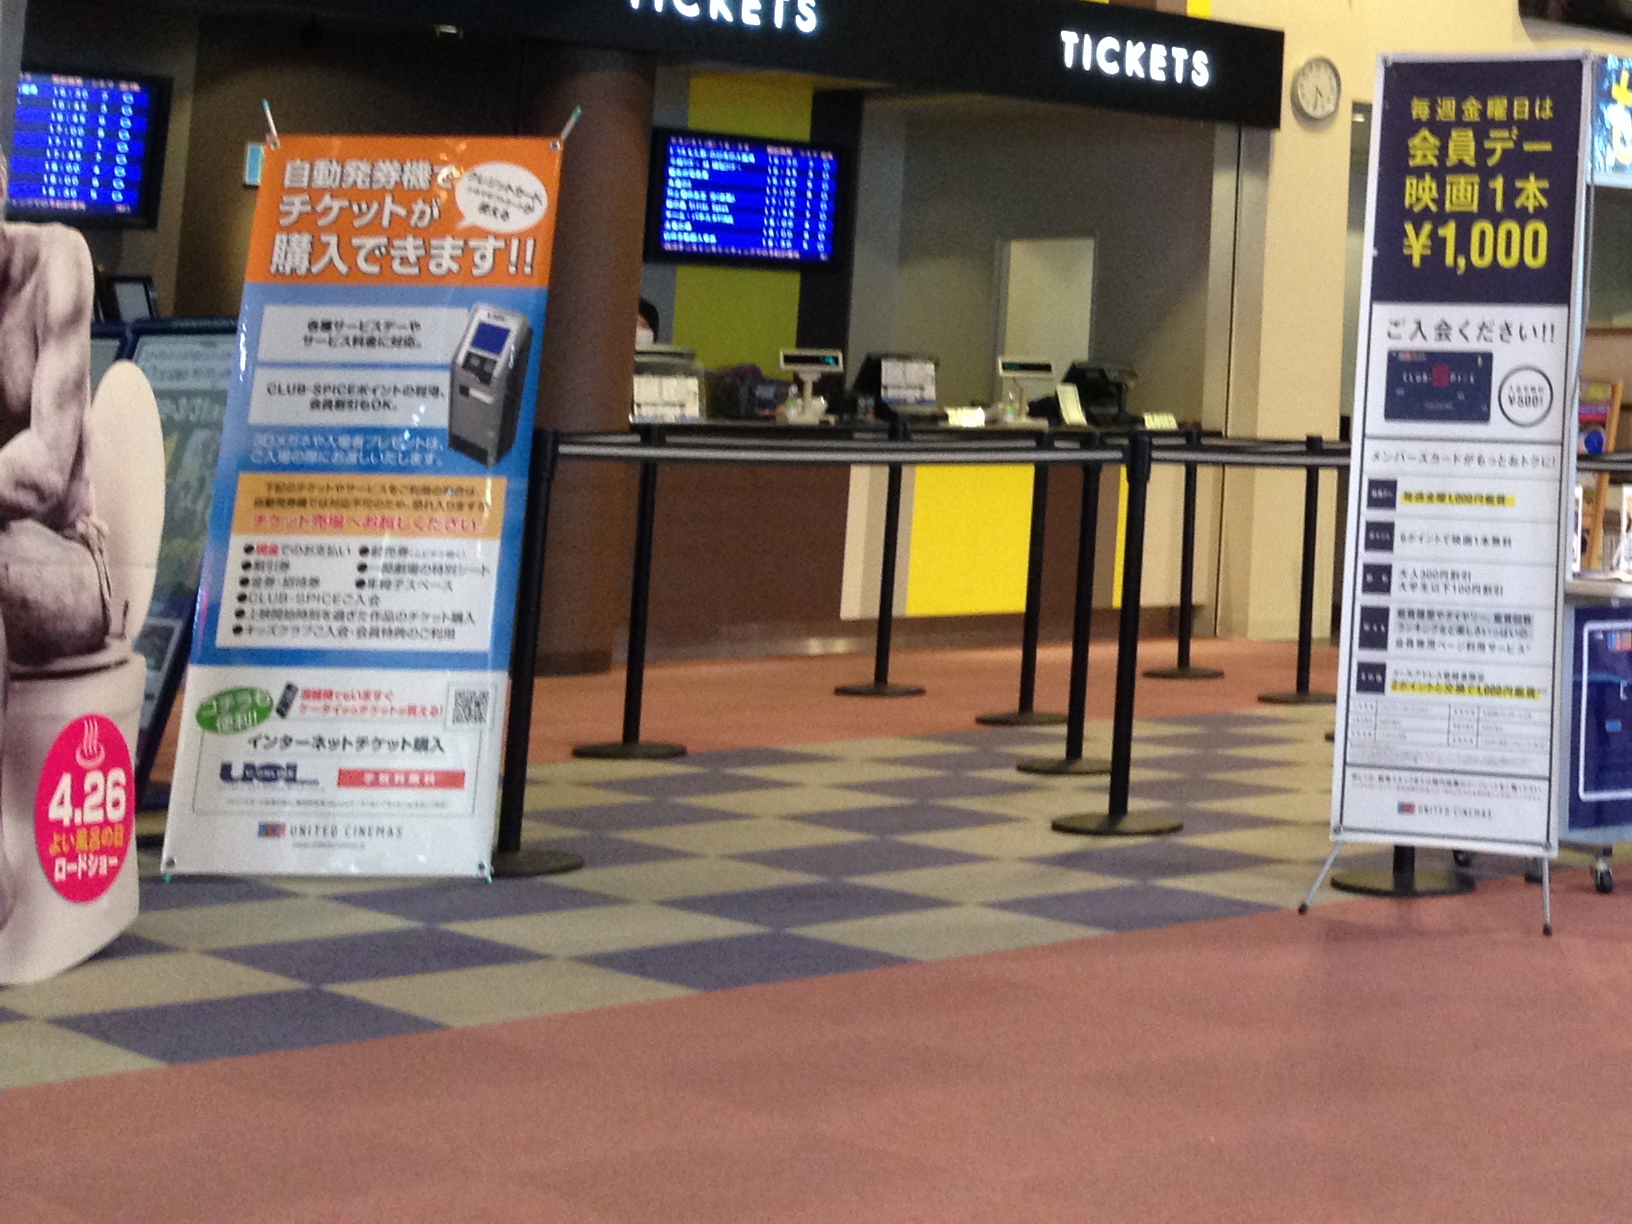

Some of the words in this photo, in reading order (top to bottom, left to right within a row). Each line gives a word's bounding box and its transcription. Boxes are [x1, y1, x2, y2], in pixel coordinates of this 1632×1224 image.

[1060, 30, 1210, 87] TICKETS
[1411, 96, 1553, 121] 毎週金曜日は
[1408, 126, 1552, 167] 会員デー
[284, 159, 461, 190] 自動発券機で
[279, 193, 441, 228] チケットが
[270, 233, 536, 277] 購入できます!!
[1403, 219, 1549, 276] ¥1,000
[1387, 319, 1555, 343] ご入会ください!!
[247, 734, 446, 754] インターネットチケット購入
[48, 767, 127, 826] 4.26
[290, 825, 338, 839] UNITED
[344, 826, 403, 839] CINEMAS
[54, 851, 119, 883] ロードショー
